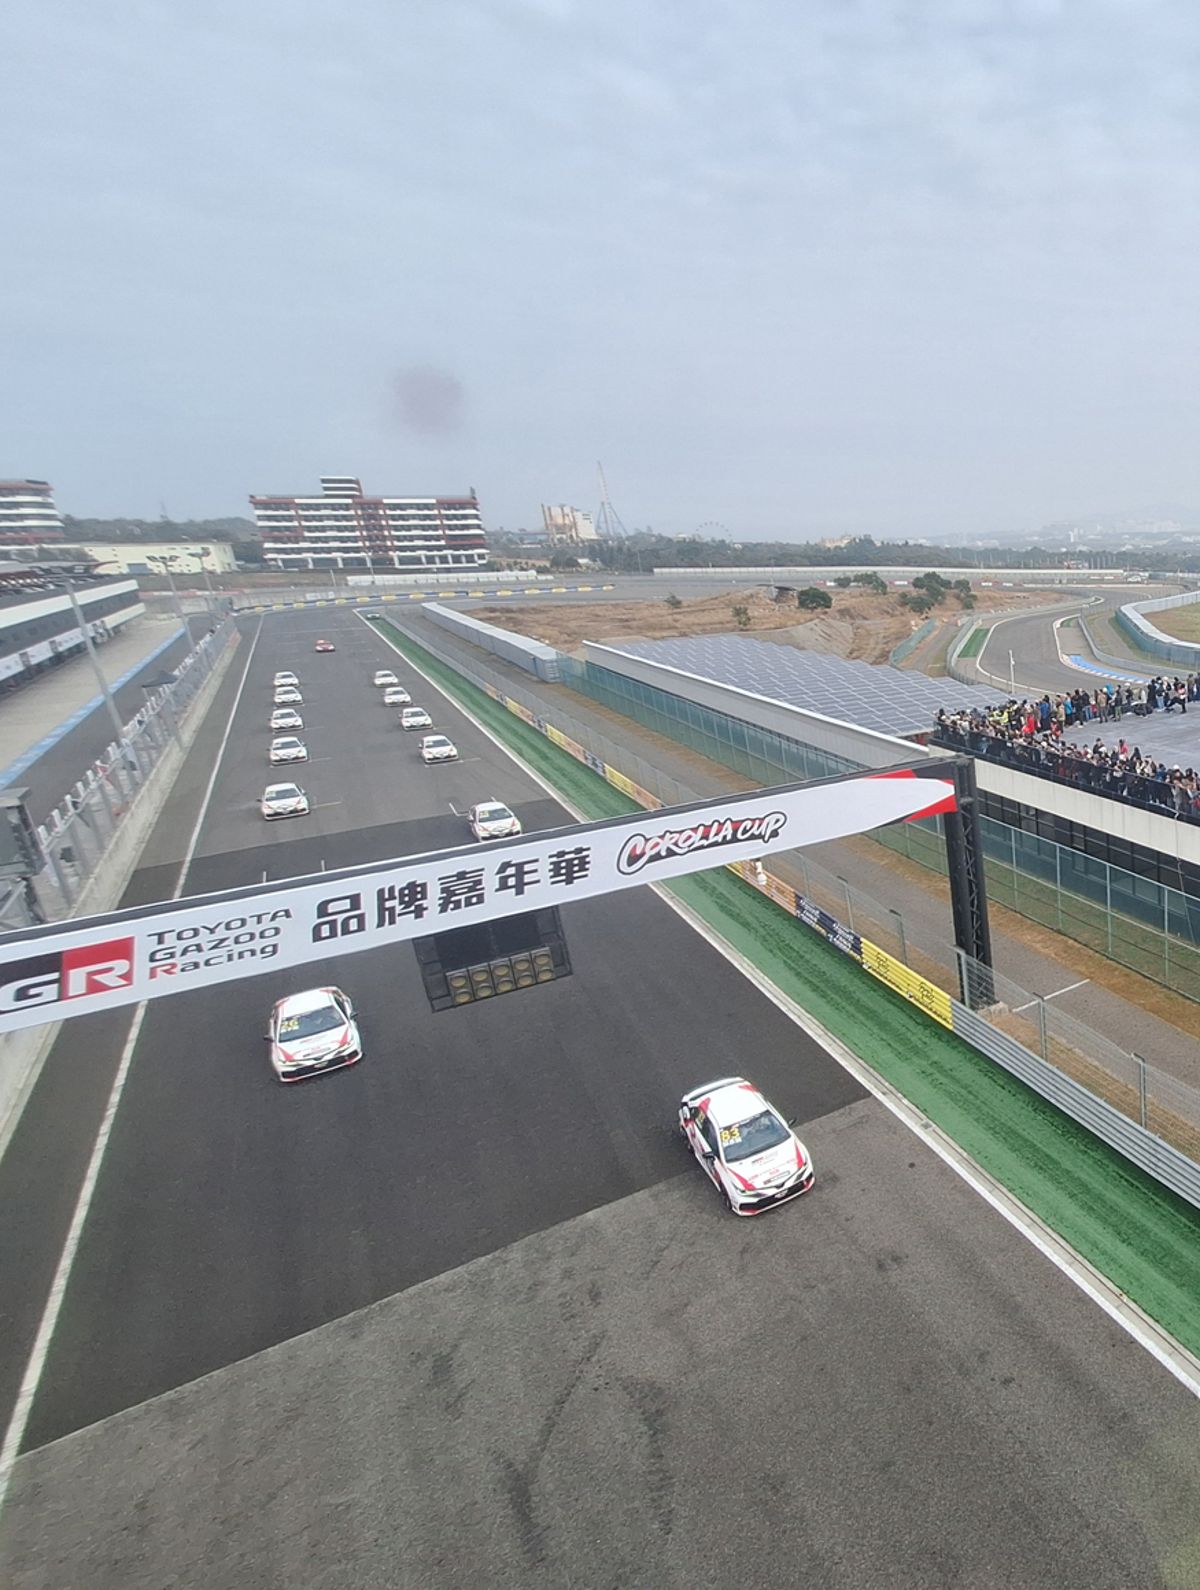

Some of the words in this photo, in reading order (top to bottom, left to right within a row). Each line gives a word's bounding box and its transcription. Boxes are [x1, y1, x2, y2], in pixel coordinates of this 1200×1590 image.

[618, 818, 732, 874] COROLLA
[736, 812, 787, 842] CUP
[312, 846, 591, 943] 品牌嘉年華
[147, 907, 293, 946] TOYOTA
[148, 926, 282, 964] GAZOO
[148, 943, 280, 980] Racing
[0, 958, 130, 1012] GR
